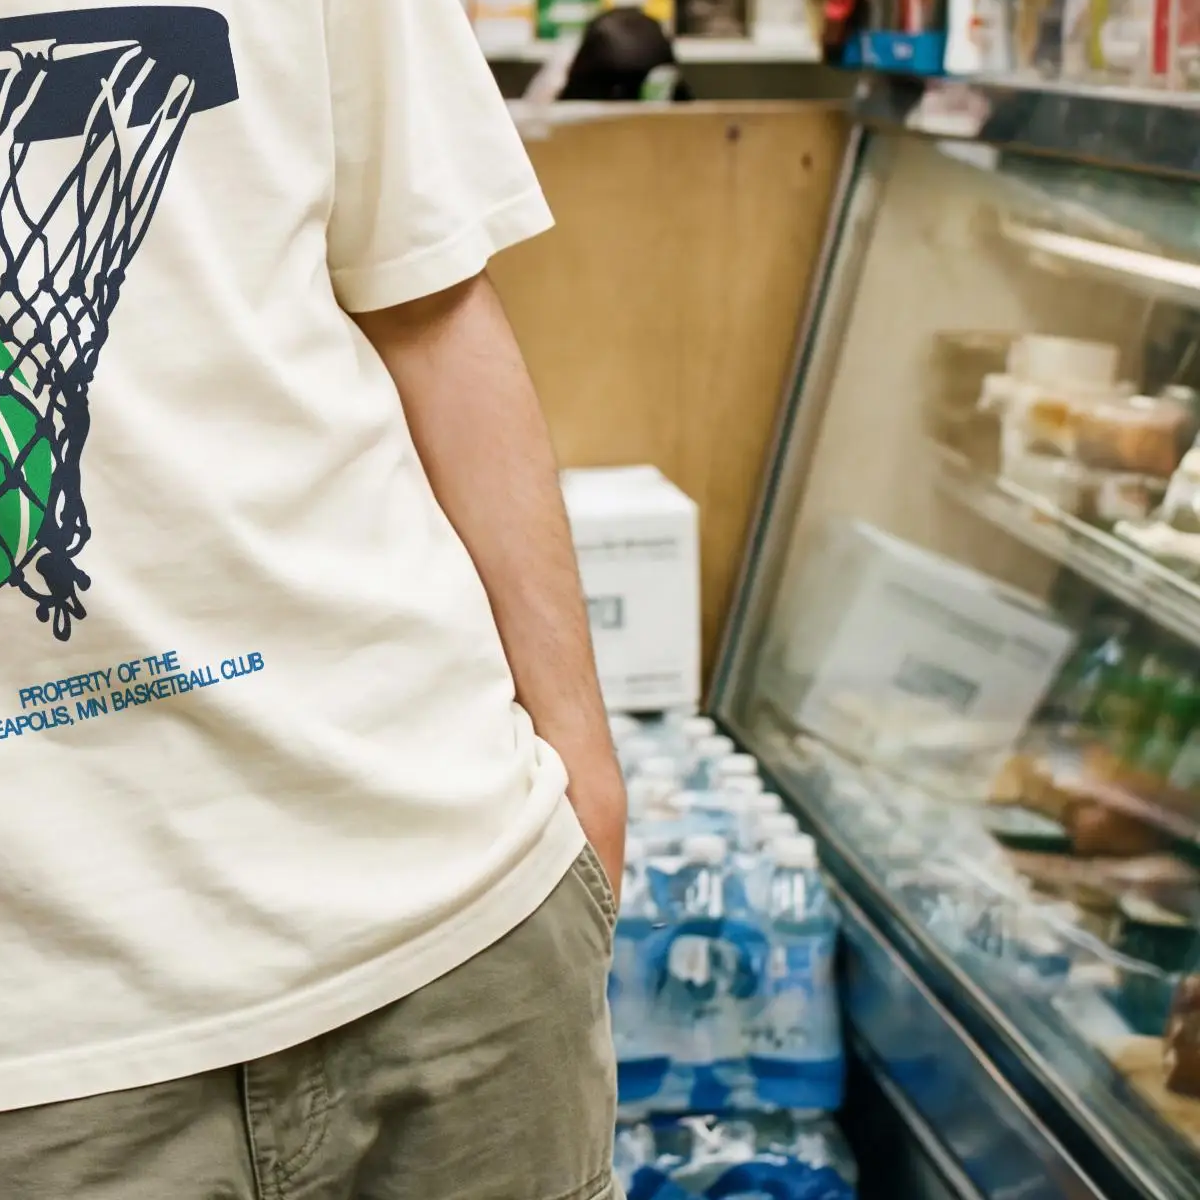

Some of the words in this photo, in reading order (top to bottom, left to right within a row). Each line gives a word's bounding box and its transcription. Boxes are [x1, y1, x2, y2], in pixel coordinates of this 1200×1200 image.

[19, 668, 112, 709] PROPERTY
[117, 659, 141, 684] OF
[142, 650, 181, 680] THE
[76, 695, 108, 721] MN
[111, 665, 219, 712] BASKETBALL
[220, 651, 265, 680] CLUB
